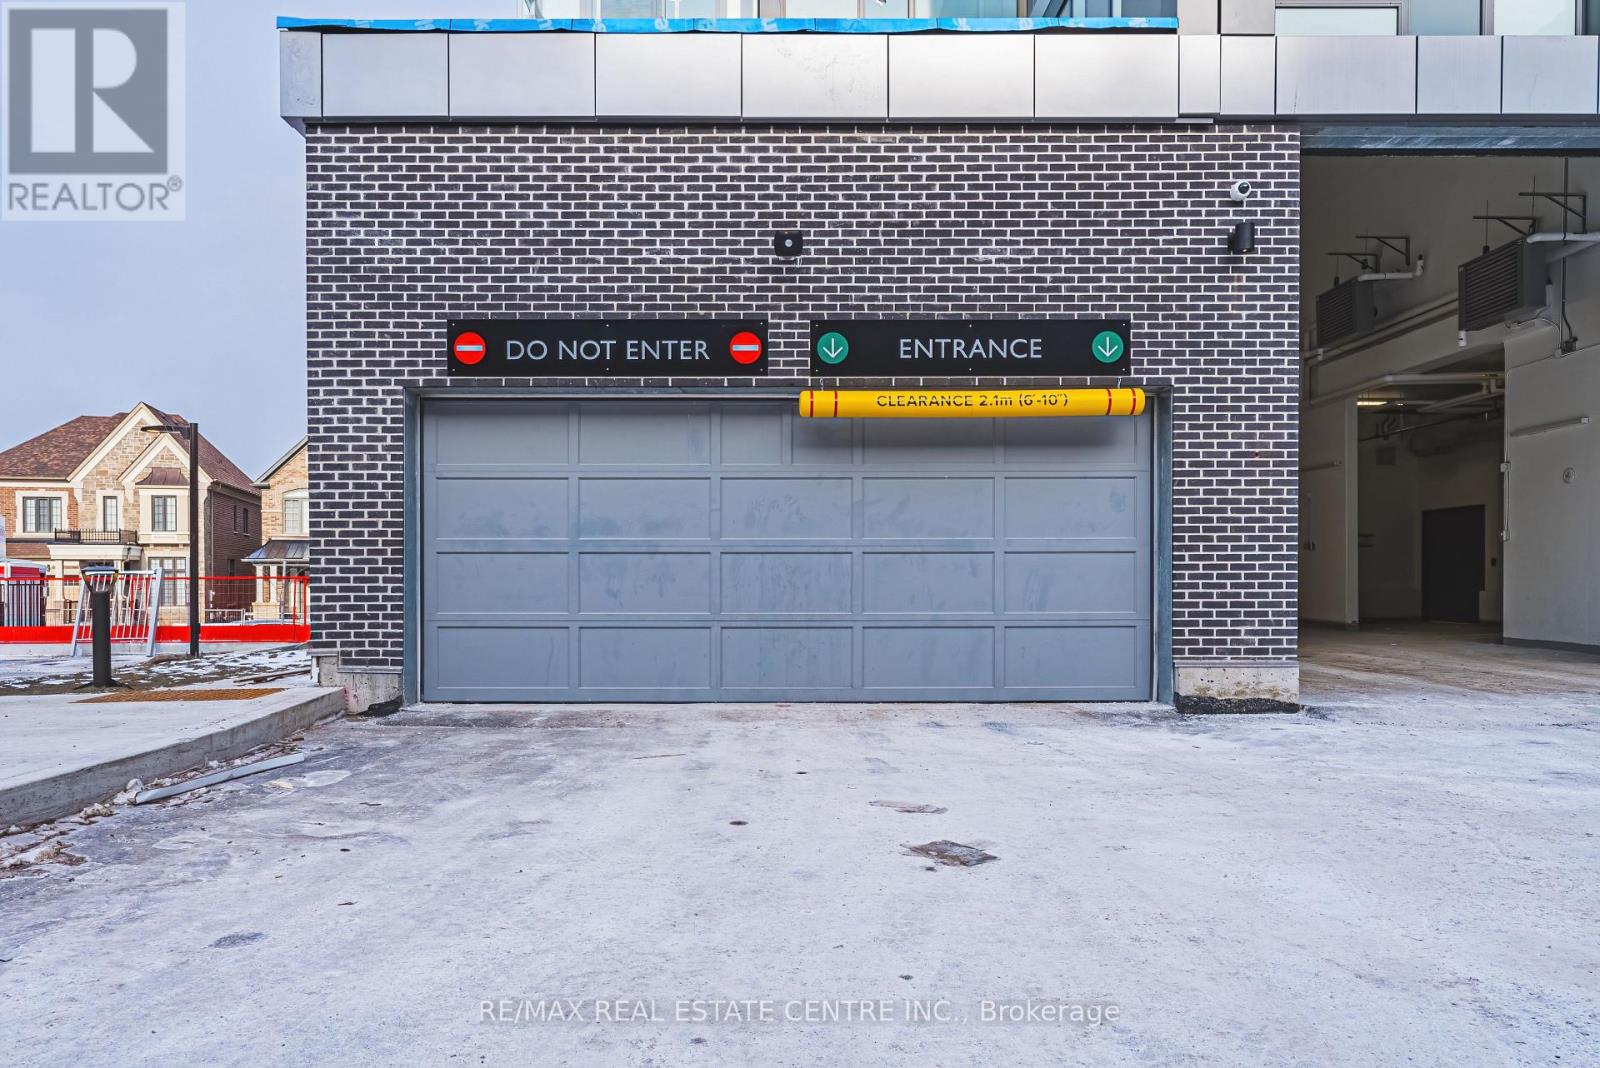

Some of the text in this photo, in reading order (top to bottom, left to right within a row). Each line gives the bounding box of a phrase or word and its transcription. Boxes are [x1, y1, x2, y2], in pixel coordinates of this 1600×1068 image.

[506, 340, 710, 360] DO NOT ENTER
[900, 338, 1042, 359] ENTRANCE
[876, 395, 973, 407] CLEARANCE
[979, 395, 1013, 406] 2.1m
